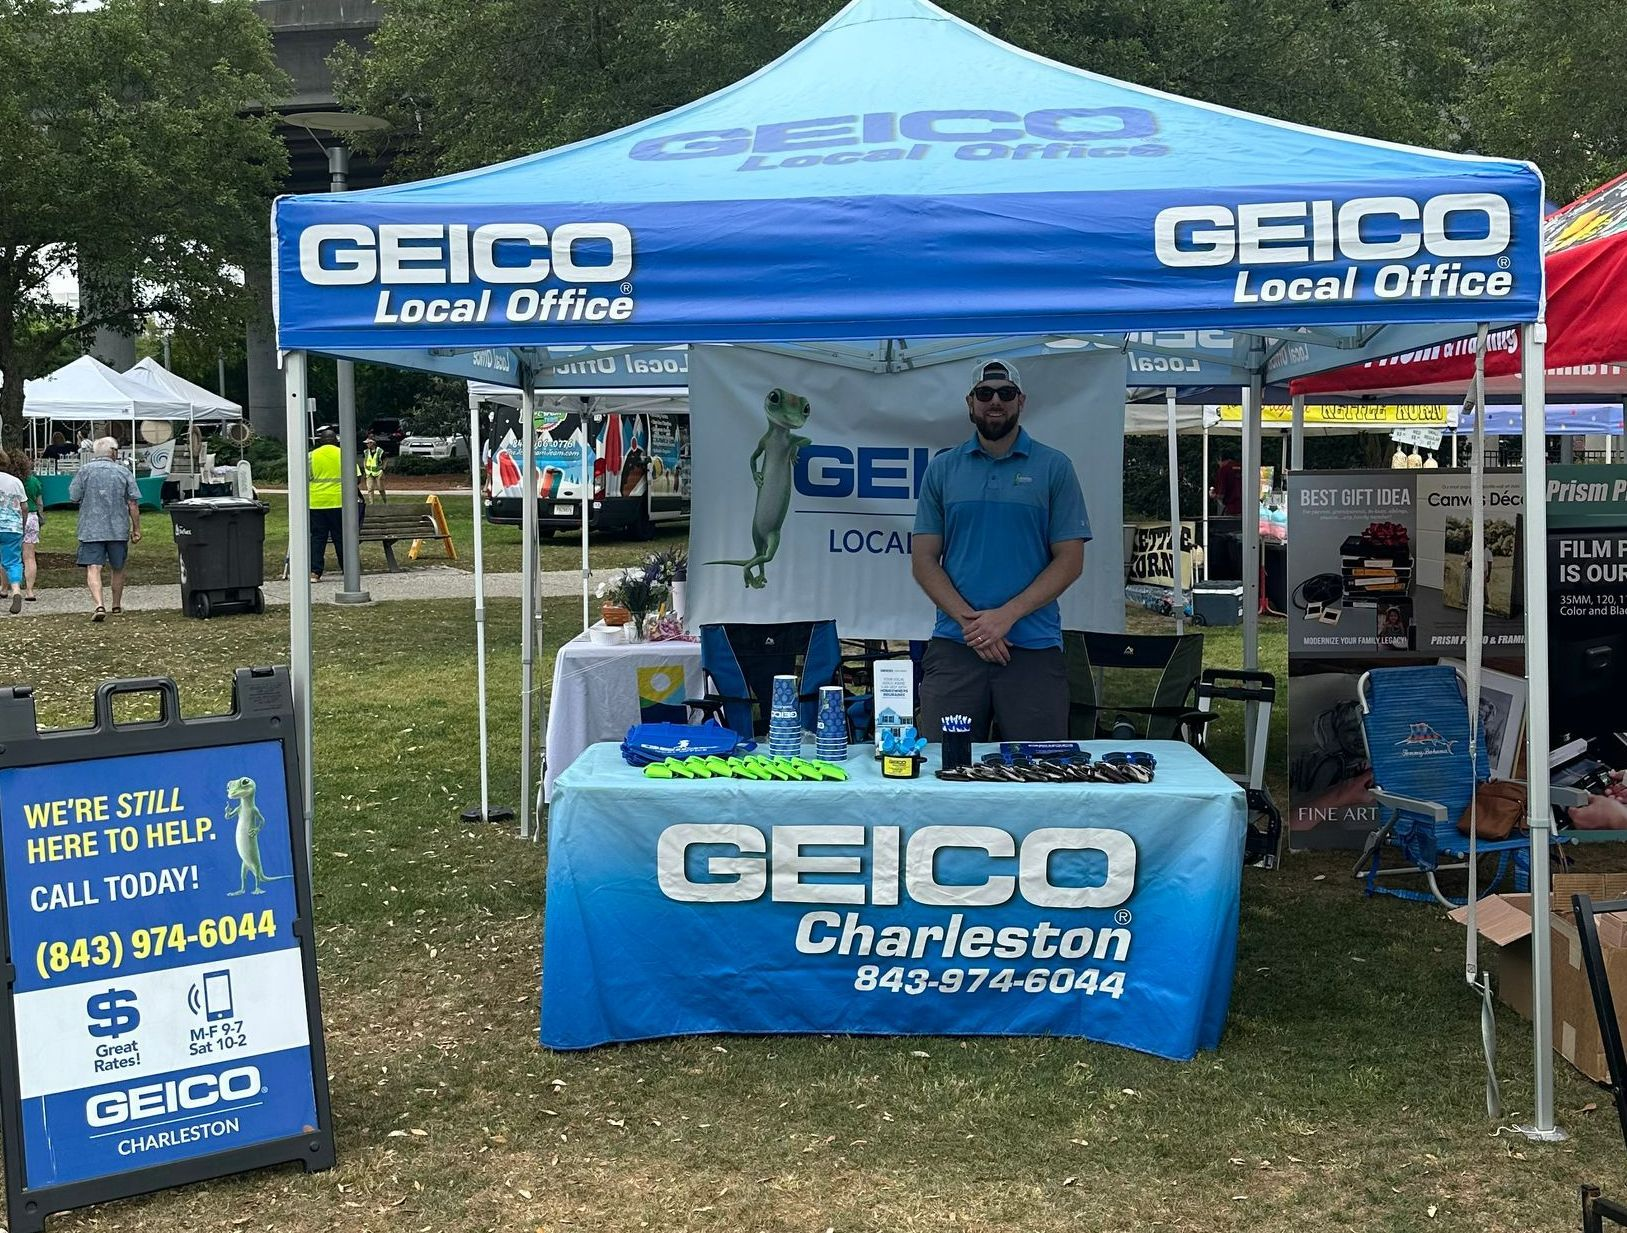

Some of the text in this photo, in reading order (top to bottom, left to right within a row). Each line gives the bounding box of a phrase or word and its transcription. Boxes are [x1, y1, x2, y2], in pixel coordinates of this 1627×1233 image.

[628, 106, 1161, 163] GEICO
[736, 141, 1170, 172] Local Office
[1154, 193, 1511, 268] GEICO
[299, 222, 633, 286] GEICO
[1233, 262, 1514, 304] Local Office
[373, 288, 634, 324] Local Office
[794, 445, 955, 500] GEI
[1300, 487, 1412, 507] BEST GIFT IDEA
[1428, 489, 1524, 507] Canvs Déc
[1546, 479, 1627, 502] Prism P
[1560, 539, 1612, 559] FILM
[1560, 564, 1581, 583] IS
[1560, 594, 1594, 606] 35MM,
[1596, 594, 1617, 606] 120,
[1560, 606, 1586, 616] Color
[1588, 606, 1608, 615] and
[1303, 636, 1340, 645] MODERNIZE
[1341, 636, 1357, 645] YOUR
[1358, 636, 1381, 645] FAMILY
[1431, 635, 1459, 645] PRISM
[1489, 636, 1497, 645] &
[1498, 635, 1525, 645] FRAMI
[23, 787, 185, 830] WE'RE STILL
[1299, 807, 1379, 821] FINE ART
[27, 817, 217, 864] HERE TO HELP.
[656, 823, 1137, 909] GEICO
[30, 865, 199, 913] CALL TODAY!
[36, 909, 277, 980] (843) 974-6044
[794, 910, 1133, 963] Charleston
[853, 964, 1127, 1000] 843-974-6044
[189, 1034, 247, 1056] Sat 10-2
[190, 1021, 244, 1042] M-F 9-7
[94, 1053, 141, 1073] Rates!
[96, 1040, 139, 1058] Great
[86, 1065, 262, 1128] GEICO
[118, 1118, 240, 1156] CHARLESTON
